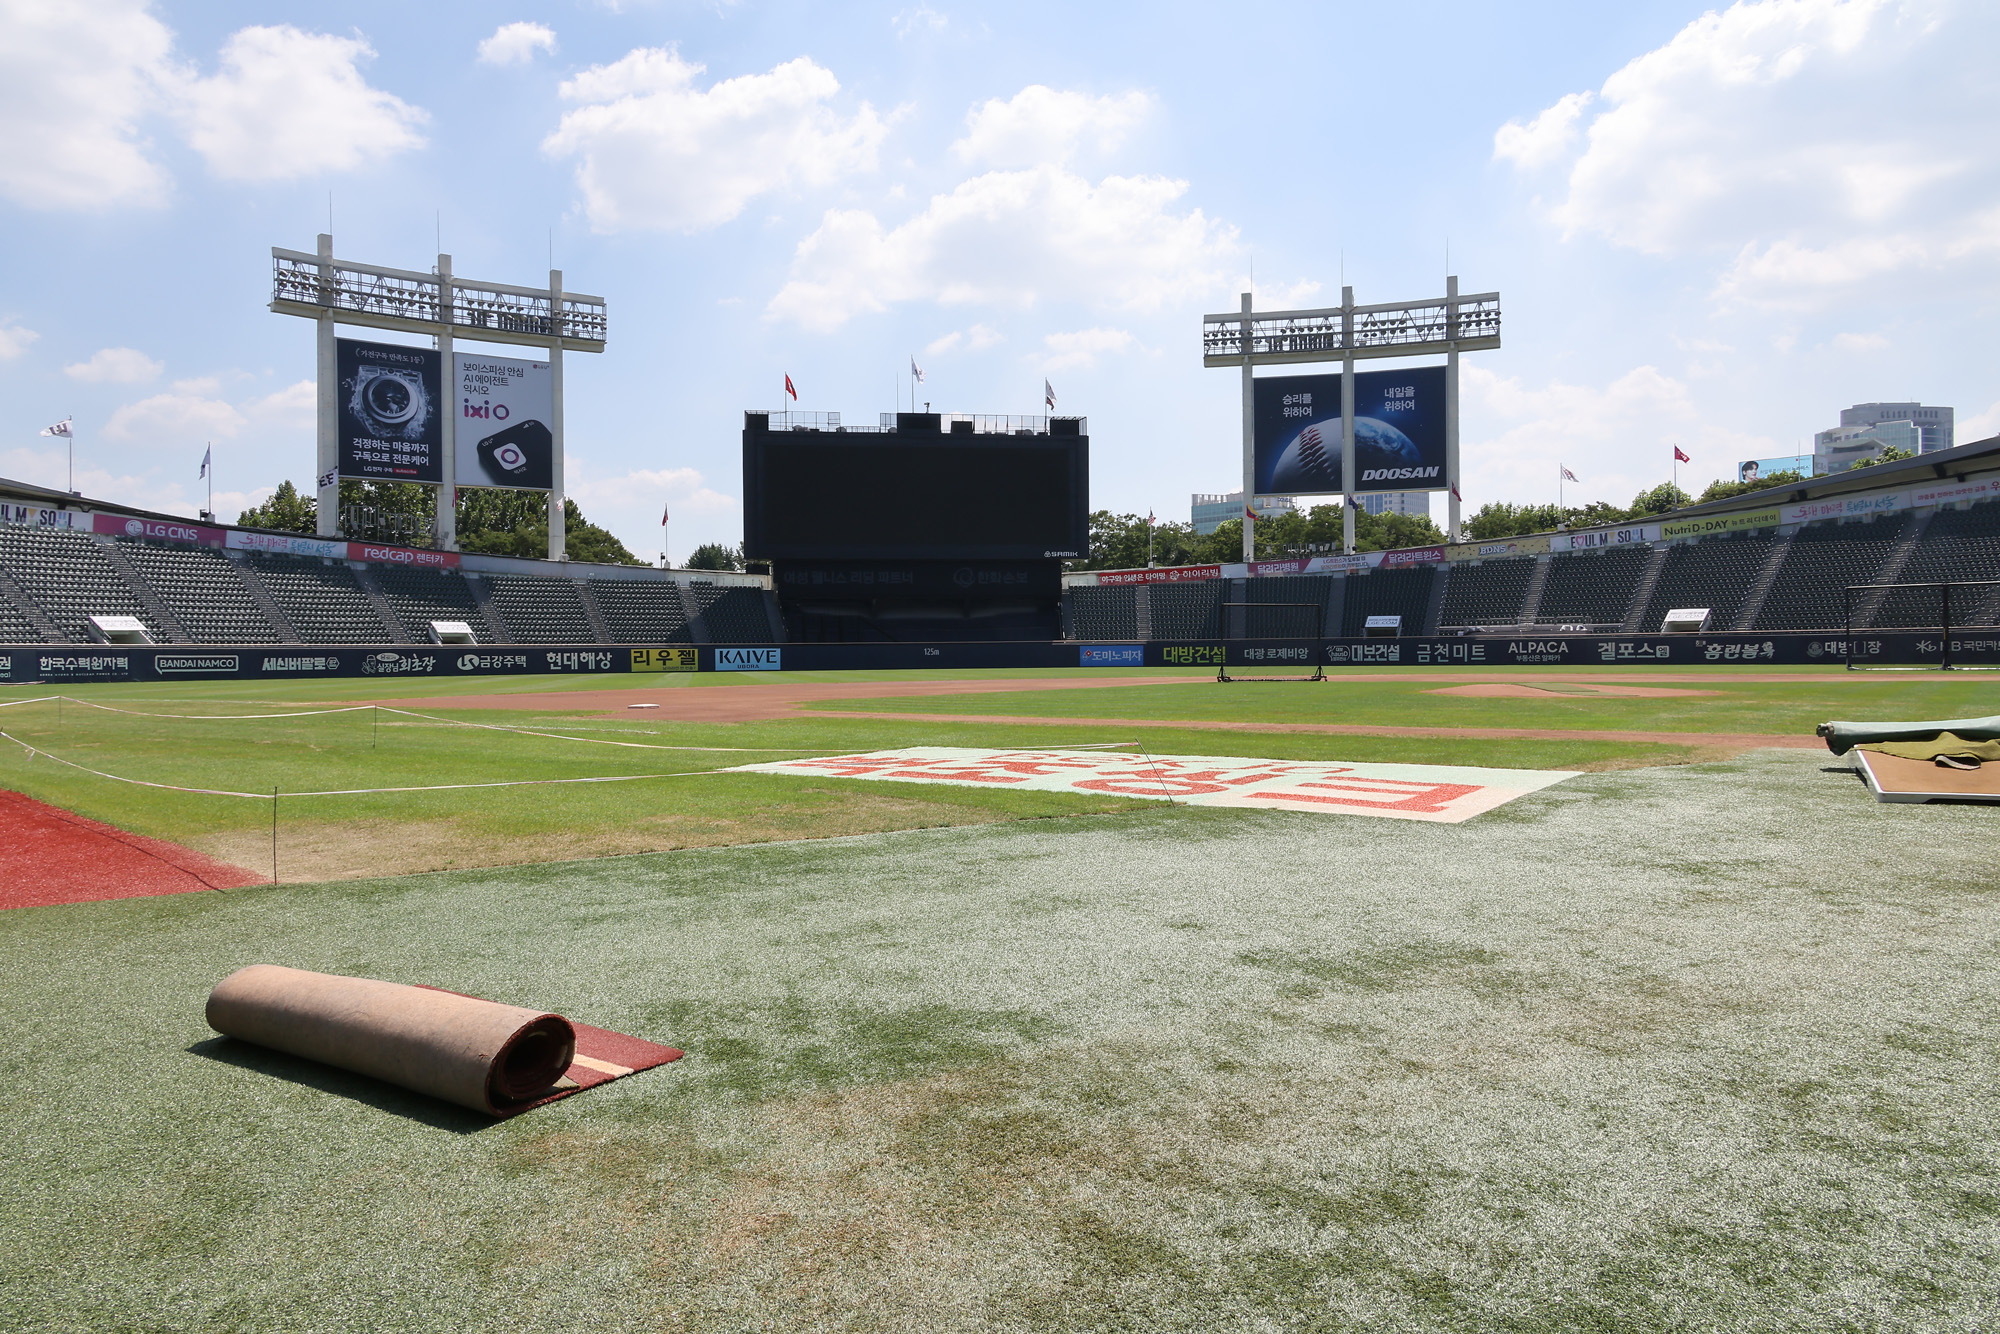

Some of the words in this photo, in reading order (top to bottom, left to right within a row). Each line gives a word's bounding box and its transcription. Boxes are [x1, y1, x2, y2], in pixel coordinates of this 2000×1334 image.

[463, 363, 505, 376] 보이스피싱
[507, 367, 524, 377] 안심
[464, 374, 473, 383] AI
[475, 374, 509, 386] 에이전트
[463, 384, 489, 395] 익시오
[1384, 386, 1415, 399] 내일을
[1282, 393, 1312, 405] 승리를
[1283, 406, 1312, 418] 위하여
[1384, 400, 1415, 412] 위하여
[353, 438, 391, 450] 걱정하는
[392, 441, 429, 454] 마음까지
[353, 450, 390, 462] 구독으로
[393, 454, 429, 466] 전문케어
[1361, 466, 1439, 481] DOOSAN
[146, 525, 166, 537] LG
[168, 526, 198, 541] CNS
[364, 547, 414, 564] redcap
[416, 553, 445, 565] 렌터카
[1389, 550, 1441, 563] 달려라트윈스
[1479, 544, 1506, 556] BDNS
[1182, 569, 1218, 578] 하이리빙
[1257, 562, 1299, 574] 달려라병원
[851, 571, 874, 585] 리딩
[878, 571, 913, 585] 파트너
[978, 571, 1028, 584] 한화손보
[1101, 575, 1122, 583] 야구와
[1123, 573, 1144, 582] 인생은
[1145, 572, 1166, 580] 타이밍
[924, 648, 940, 656] 125m
[1244, 649, 1266, 660] 대광
[1266, 648, 1309, 660] 로제비앙
[1352, 645, 1400, 661] 대보건설
[1417, 643, 1486, 663] 금천미트
[1508, 641, 1568, 654] ALPACA
[1704, 644, 1759, 660] 홈런볼
[546, 652, 612, 670] 현대해상
[719, 650, 777, 664] KAIVE
[1092, 650, 1142, 662] 도미노피자
[1163, 646, 1226, 664] 대방건설
[40, 657, 128, 671] 한국수력원자력
[159, 659, 196, 668] BANDAI
[197, 659, 234, 668] NAMCO
[262, 657, 326, 671] 세신버팔로
[377, 663, 399, 673] 실장님
[399, 653, 436, 672] 회초장
[480, 655, 527, 669] 금강주택
